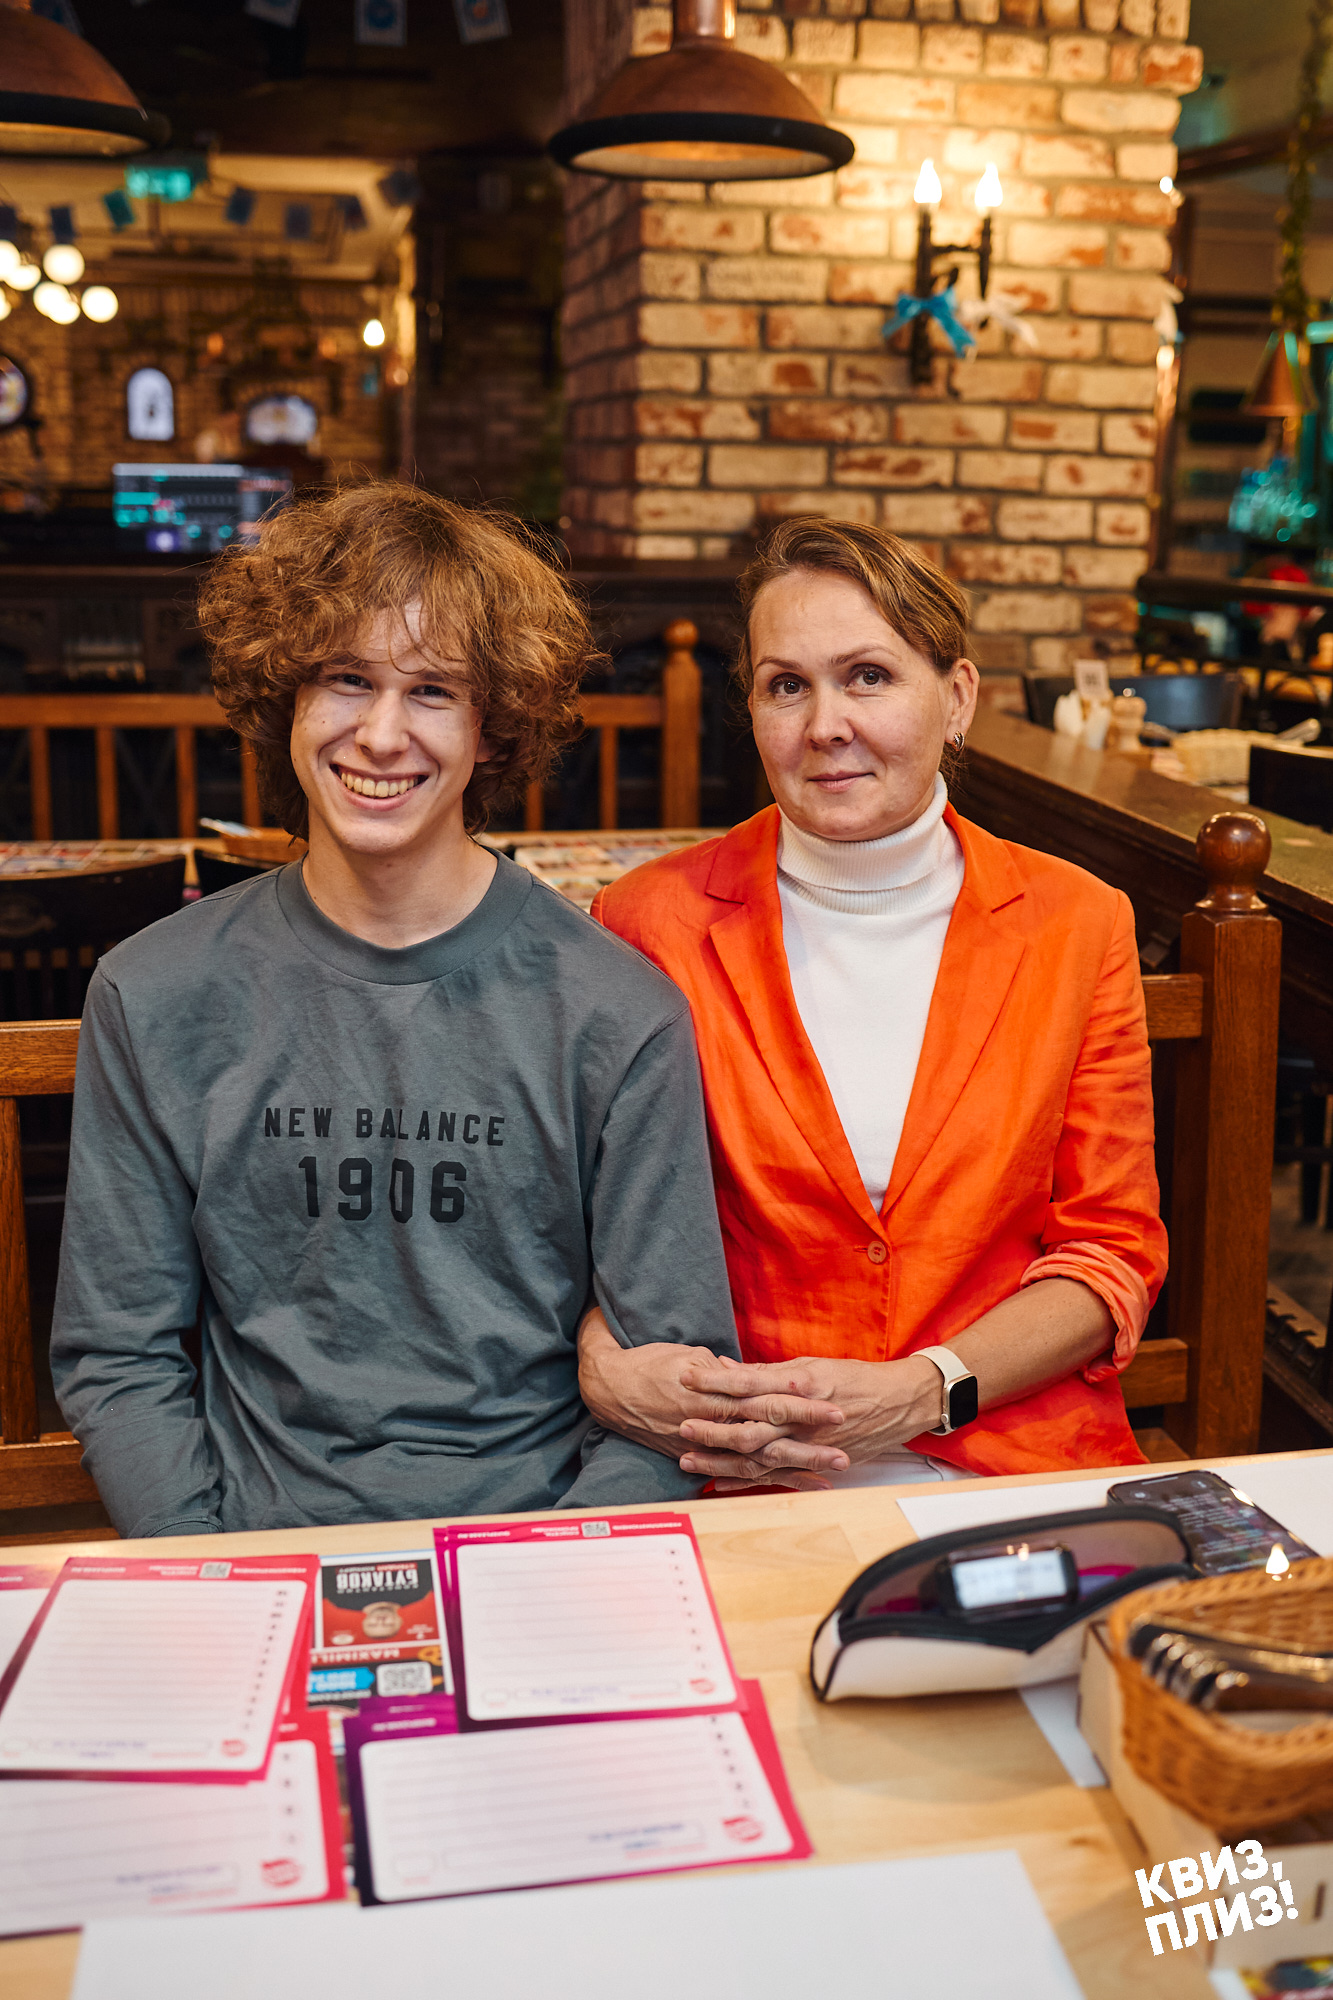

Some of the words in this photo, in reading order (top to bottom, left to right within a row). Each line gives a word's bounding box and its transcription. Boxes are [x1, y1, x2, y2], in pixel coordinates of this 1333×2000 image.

[264, 1107, 332, 1138] NEW
[356, 1107, 505, 1146] BALANCE
[298, 1156, 467, 1223] 1906
[336, 1569, 419, 1590] БУТАКОВ
